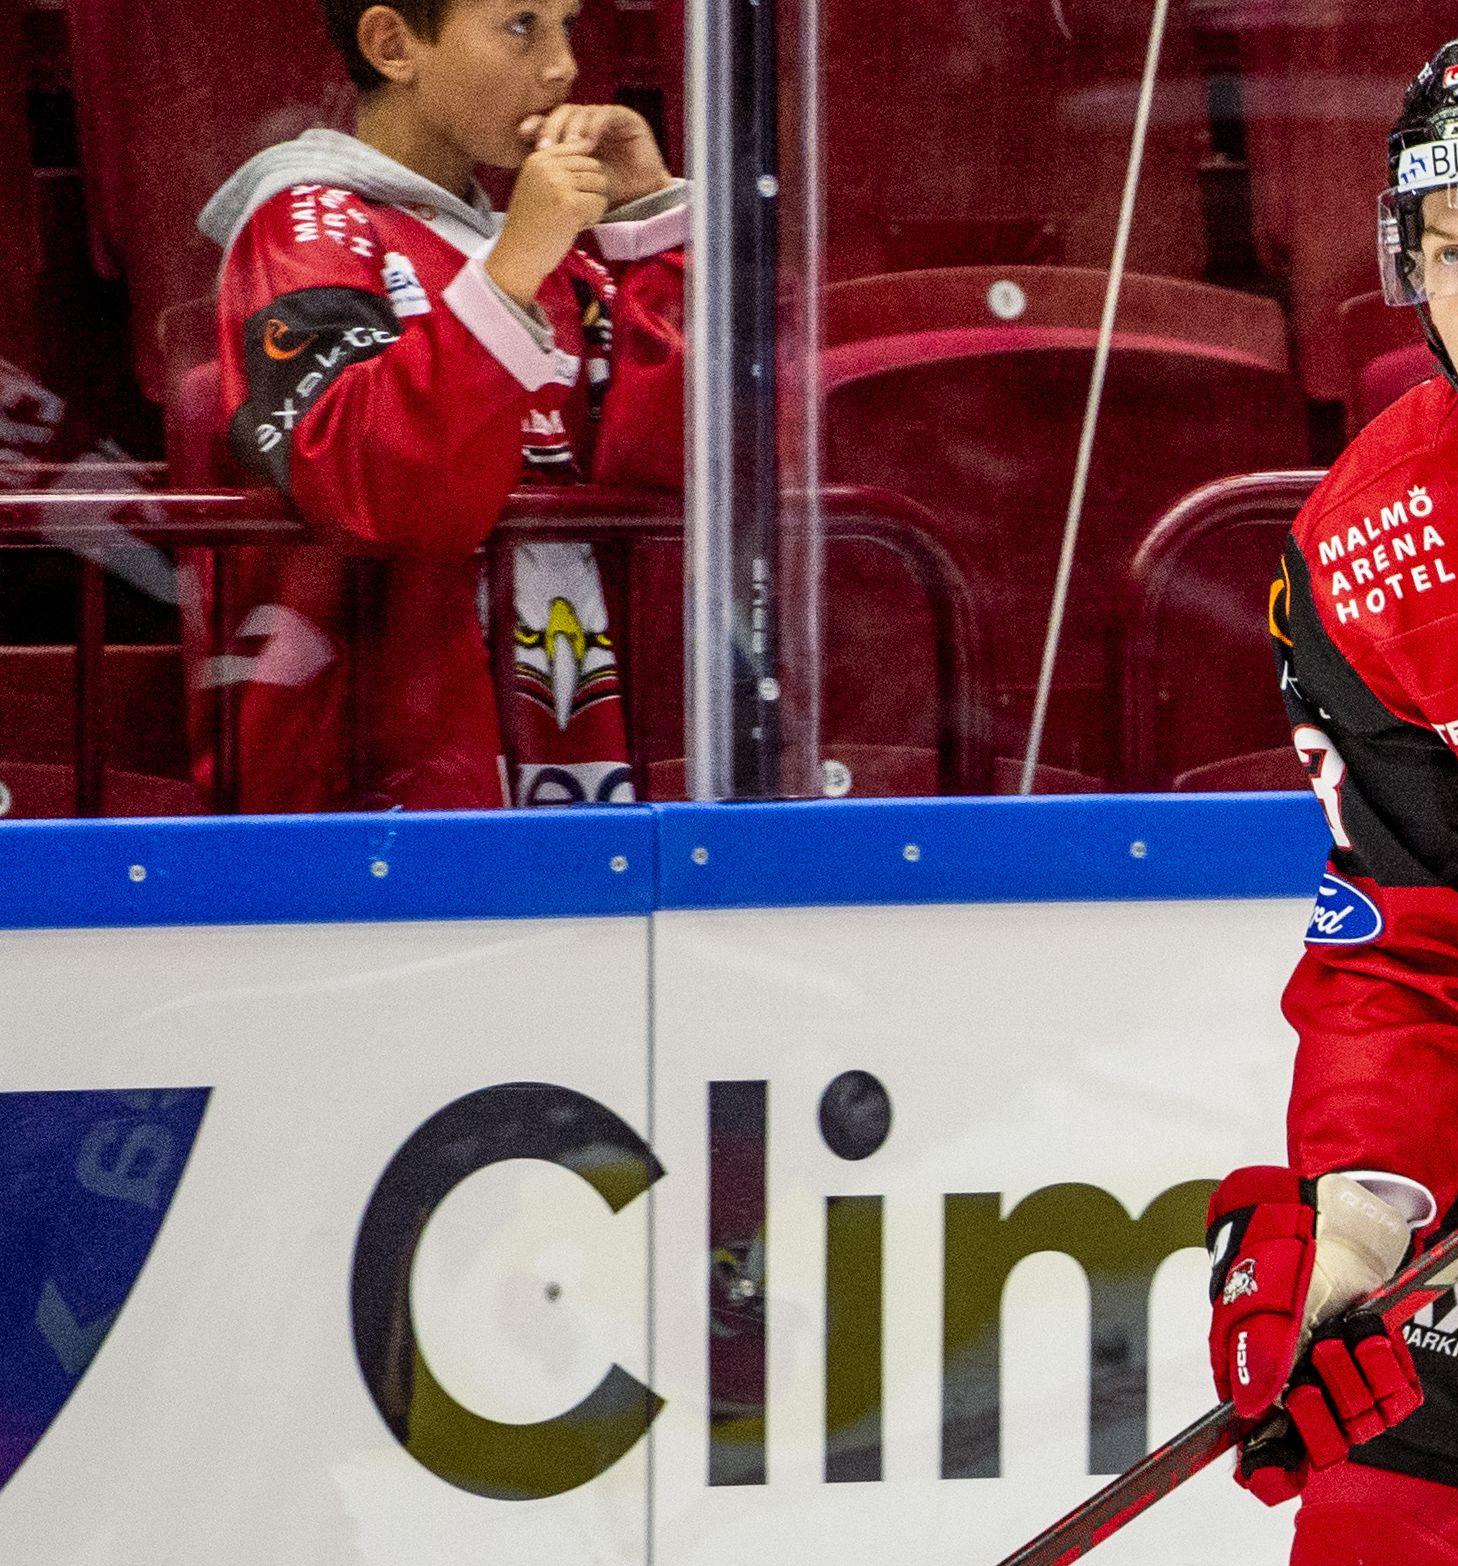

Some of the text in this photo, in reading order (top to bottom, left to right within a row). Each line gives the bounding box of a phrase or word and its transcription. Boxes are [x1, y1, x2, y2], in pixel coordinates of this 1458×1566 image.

[1332, 525, 1445, 596] ARENA
[1335, 558, 1456, 625] HOTEL
[1236, 1330, 1251, 1386] CCM
